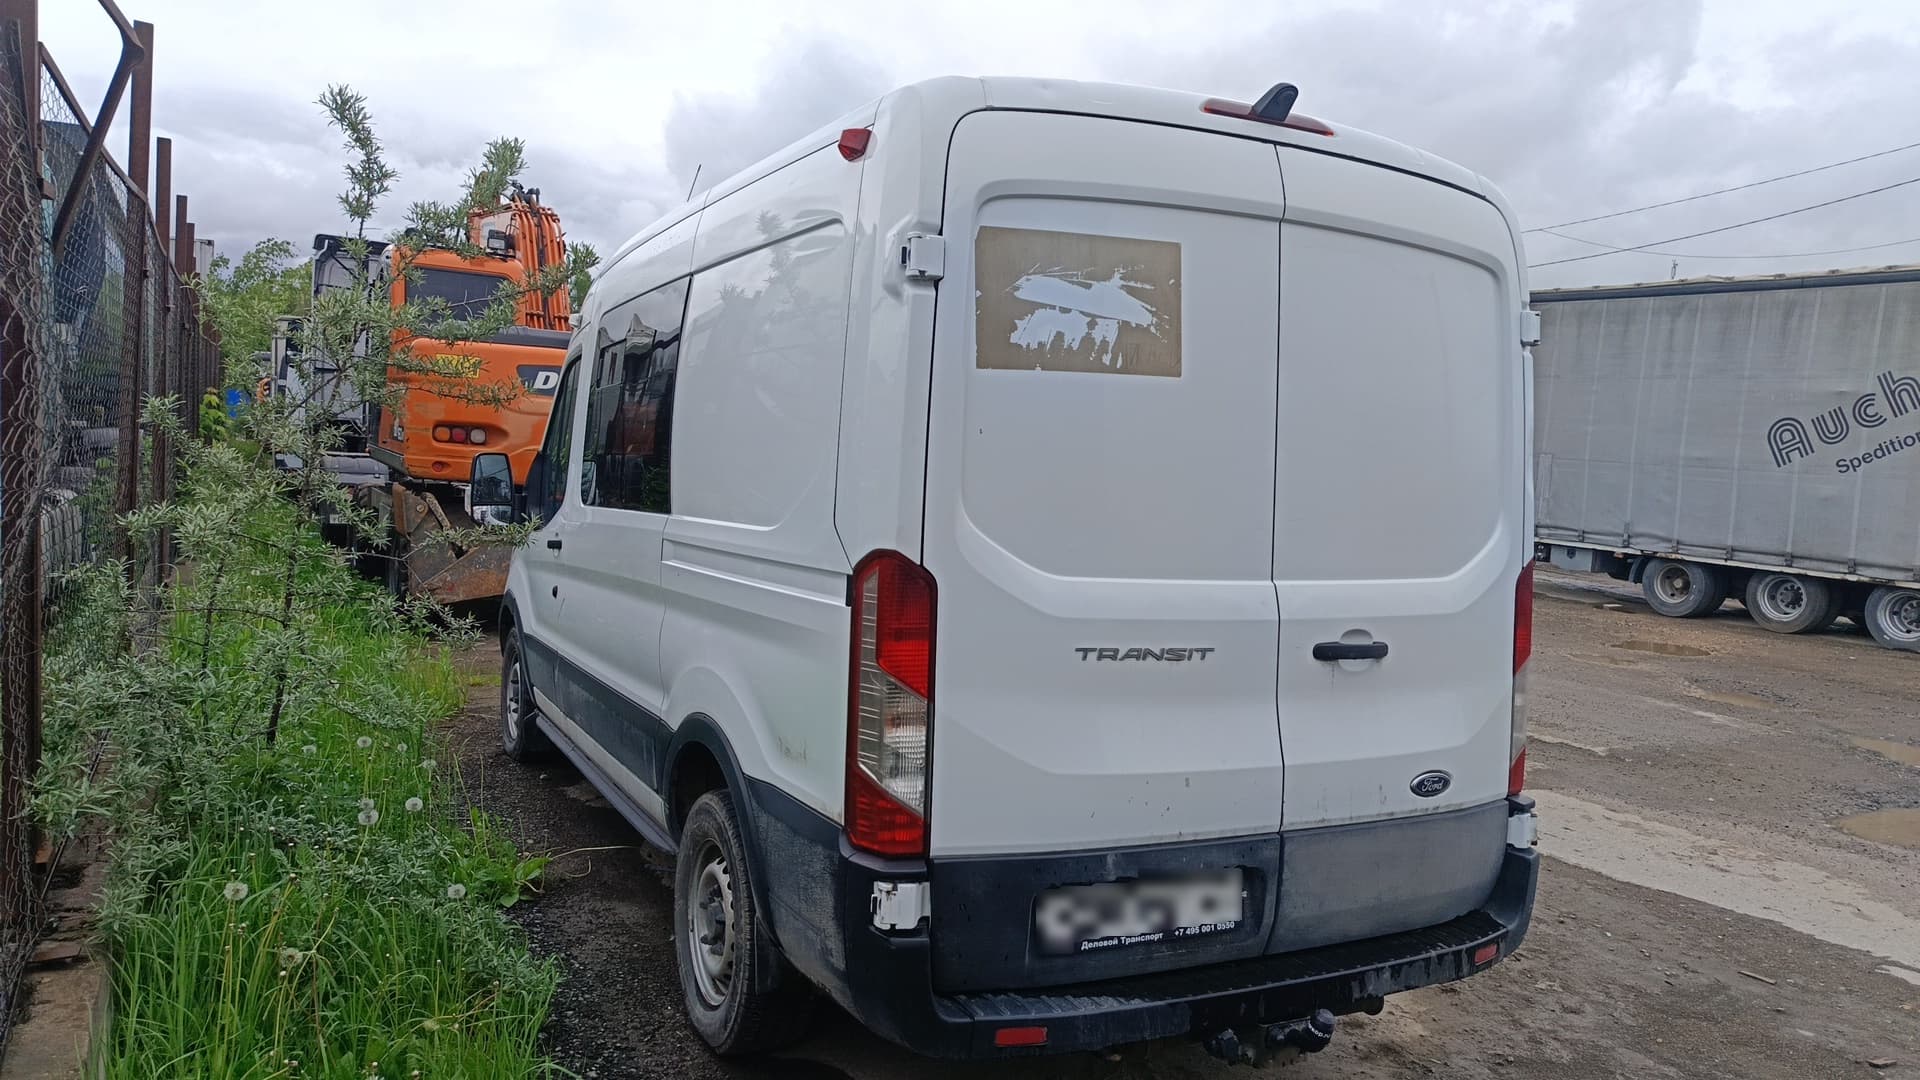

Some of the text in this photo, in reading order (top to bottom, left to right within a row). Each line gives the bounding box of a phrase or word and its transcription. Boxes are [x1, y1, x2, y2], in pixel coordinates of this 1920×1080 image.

[1075, 647, 1215, 661] TRANSIT
[1174, 928, 1184, 936] +7
[1185, 925, 1200, 935] 495
[1201, 924, 1215, 933] 001
[1081, 933, 1164, 950] Деловой Транспорт
